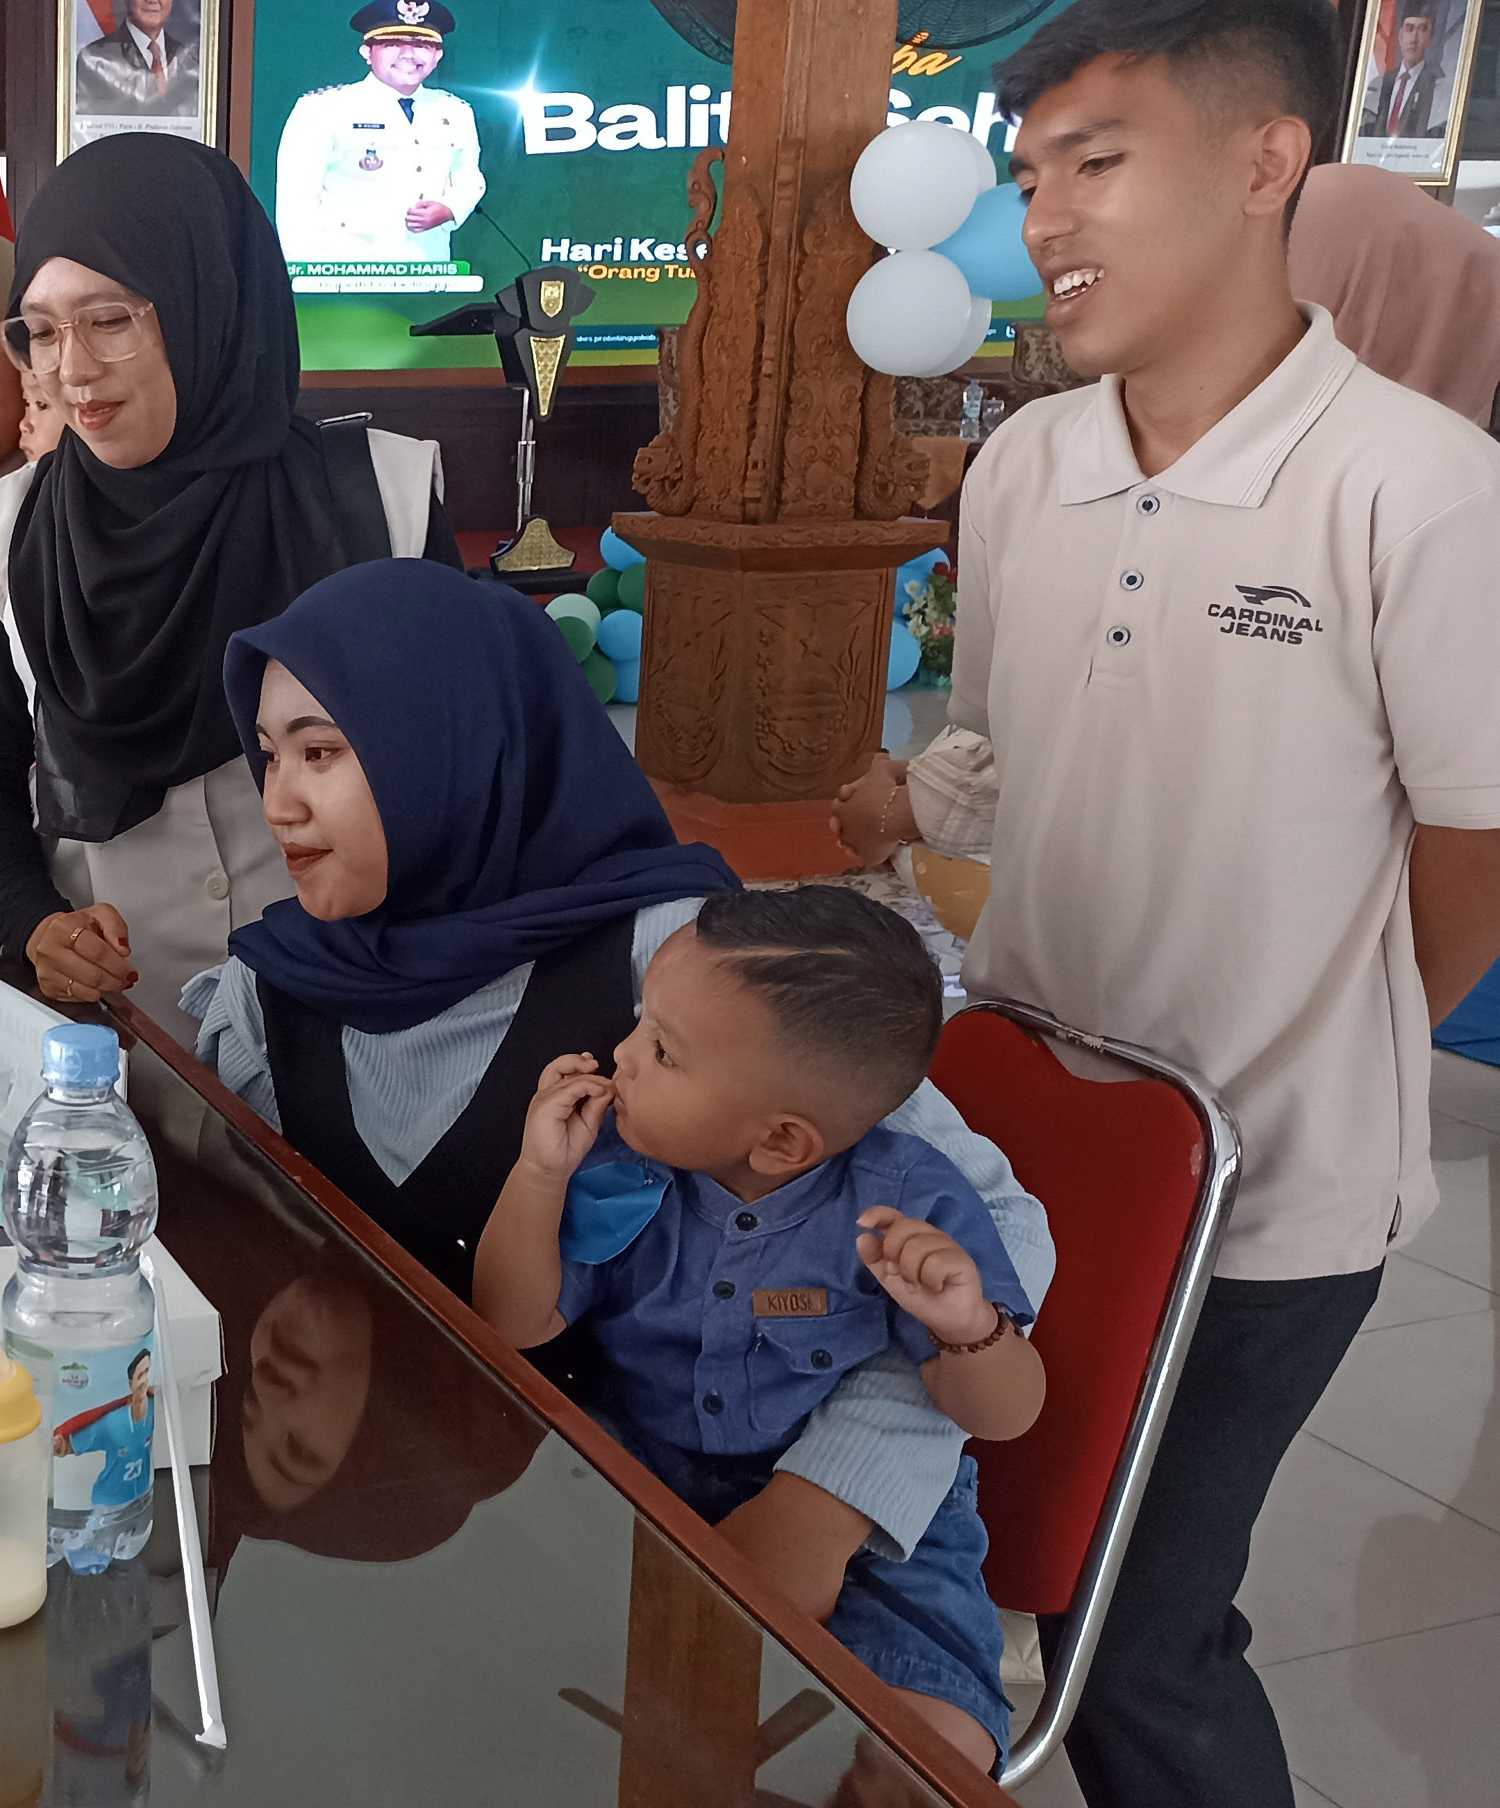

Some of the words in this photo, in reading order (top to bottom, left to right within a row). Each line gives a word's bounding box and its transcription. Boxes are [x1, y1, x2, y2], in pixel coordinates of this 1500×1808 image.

[541, 237, 623, 262] Hari
[307, 264, 407, 276] MOHAMMAD
[1207, 603, 1323, 632] CARDINAL
[1219, 621, 1303, 645] JEANS
